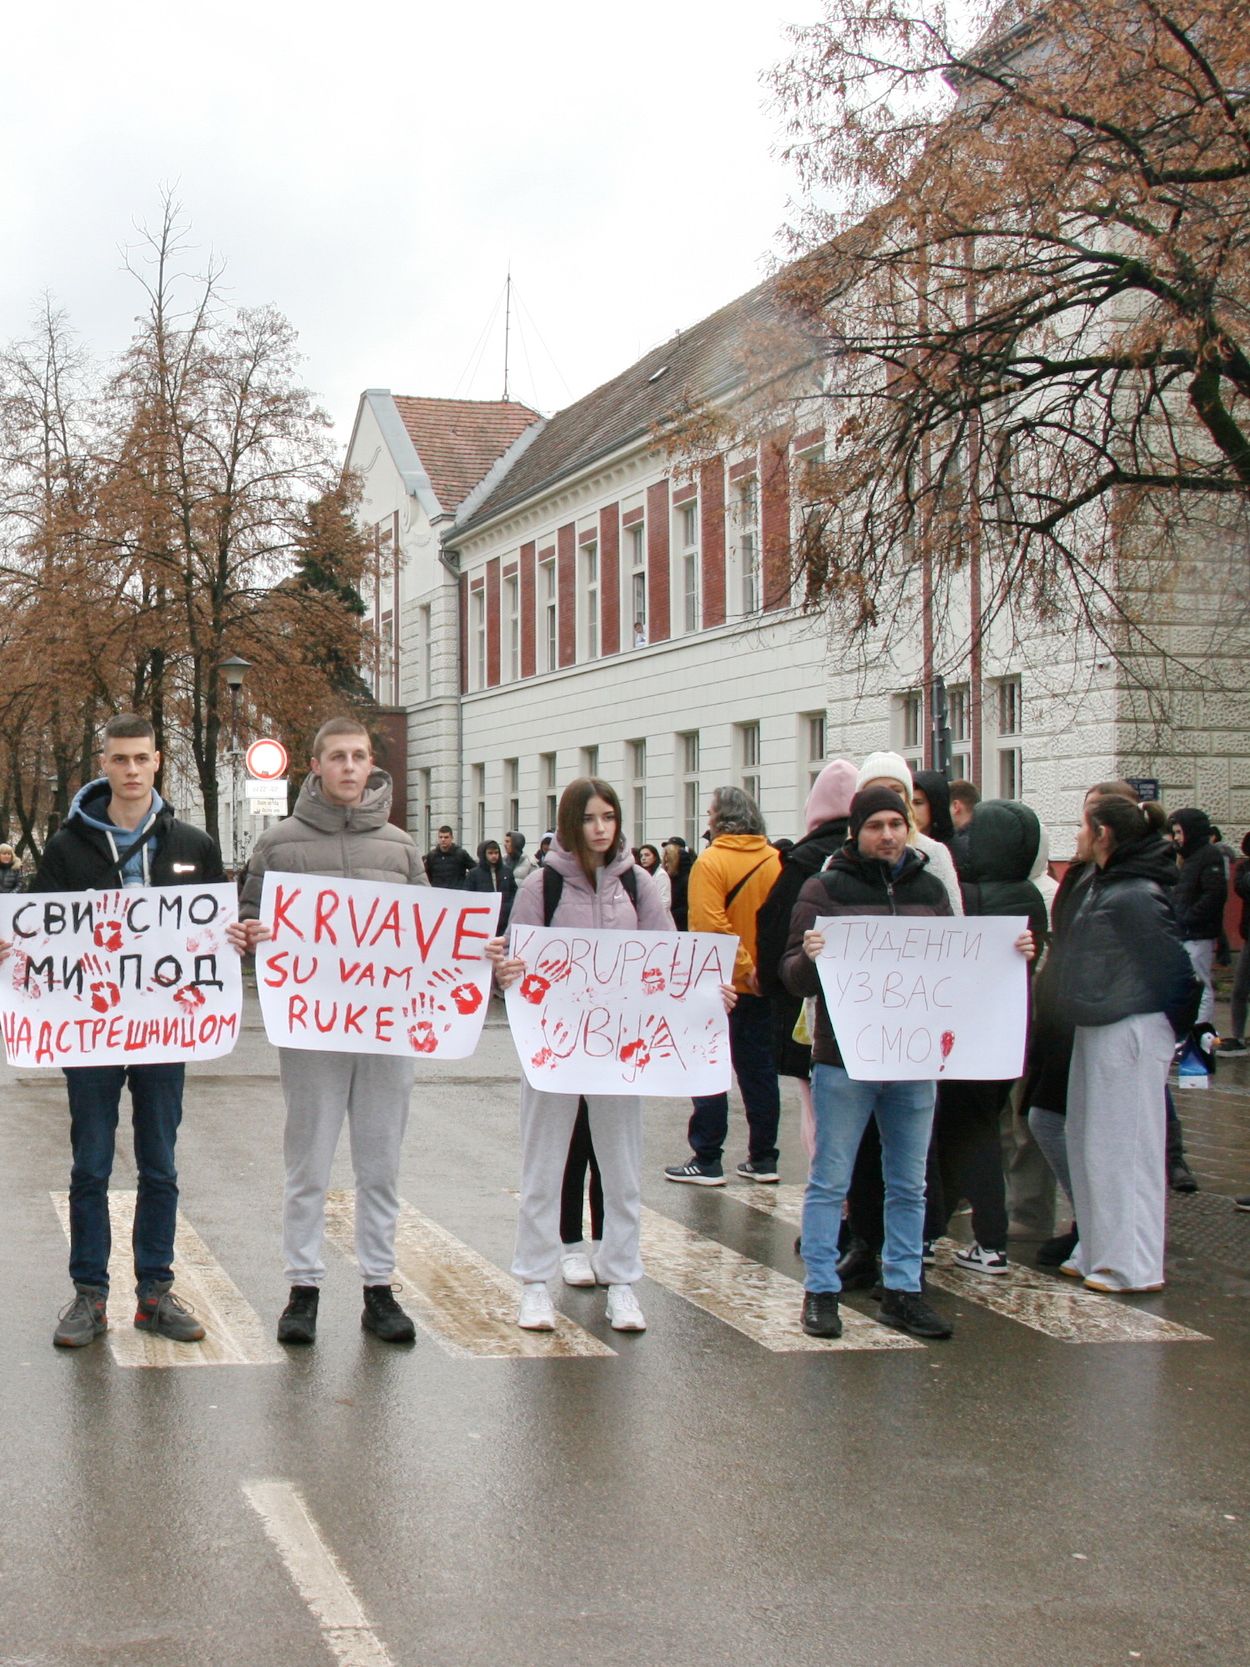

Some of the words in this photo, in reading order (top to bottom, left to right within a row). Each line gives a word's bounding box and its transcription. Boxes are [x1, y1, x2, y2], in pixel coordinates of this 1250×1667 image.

[12, 900, 94, 938] СВИ
[126, 894, 219, 933] СМО
[271, 885, 491, 963] KRVAVE
[22, 955, 84, 995] МИ
[119, 954, 224, 992] ПОД
[264, 951, 318, 988] SU
[339, 957, 414, 991] VAM
[836, 971, 874, 1007] УЗ
[882, 971, 953, 1011] ВАС
[2, 1011, 237, 1064] НАДСТРЕШНИЦОМ
[288, 994, 395, 1042] RUKE
[541, 1004, 687, 1083] UBIJA
[855, 1024, 956, 1072] СМО!
